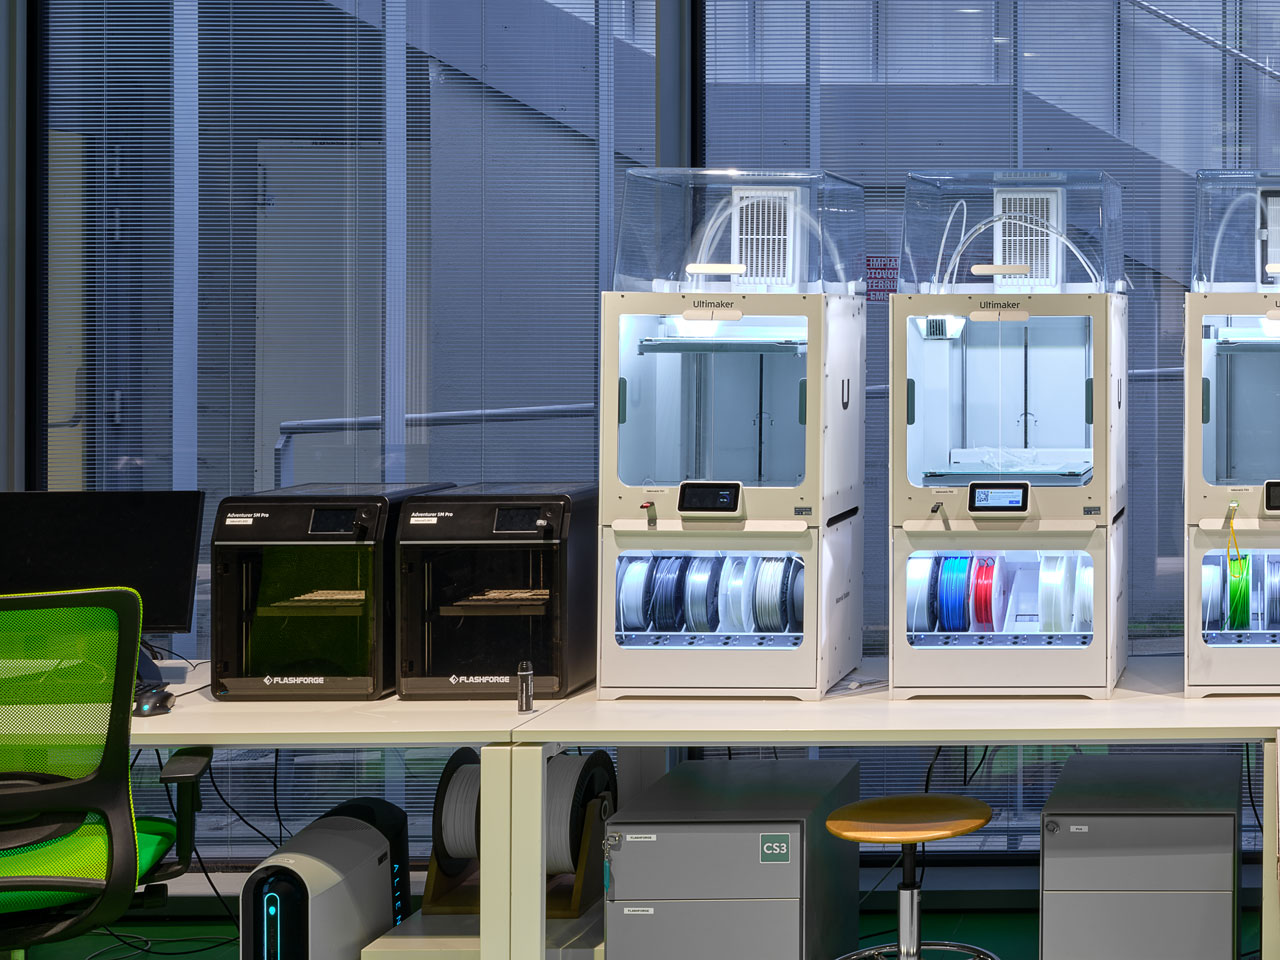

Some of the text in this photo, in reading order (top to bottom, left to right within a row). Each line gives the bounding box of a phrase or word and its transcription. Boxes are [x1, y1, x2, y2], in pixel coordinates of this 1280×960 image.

[692, 299, 735, 309] Ultimaker
[979, 300, 1021, 309] Ultimaker
[273, 676, 325, 684] FLASHFORGE
[459, 675, 510, 683] FLASHFORGE
[763, 842, 787, 854] CS3
